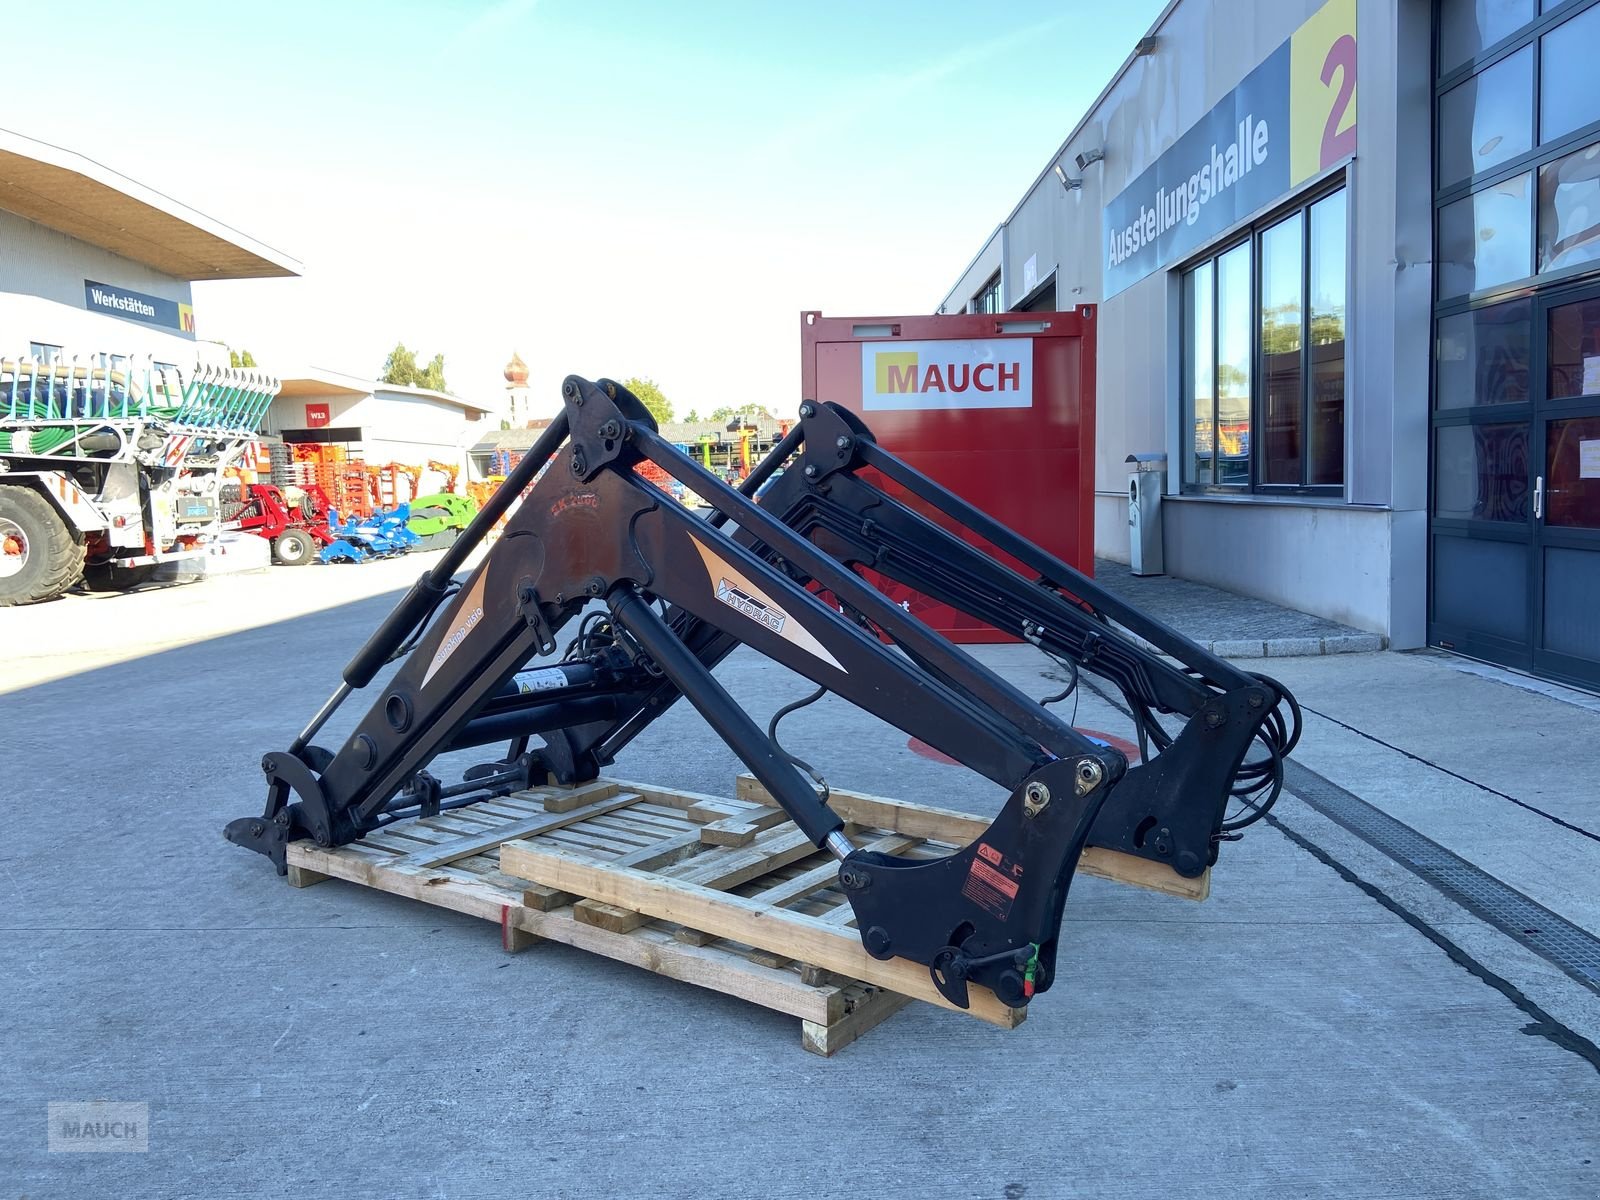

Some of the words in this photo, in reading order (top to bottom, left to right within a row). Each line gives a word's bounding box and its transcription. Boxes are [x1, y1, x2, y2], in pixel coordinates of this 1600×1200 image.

[1107, 114, 1269, 270] Ausstellungshalle
[1319, 34, 1357, 172] 2
[91, 288, 155, 317] Werkstätten
[887, 362, 1020, 394] MAUCH
[726, 592, 780, 630] HYDRAC
